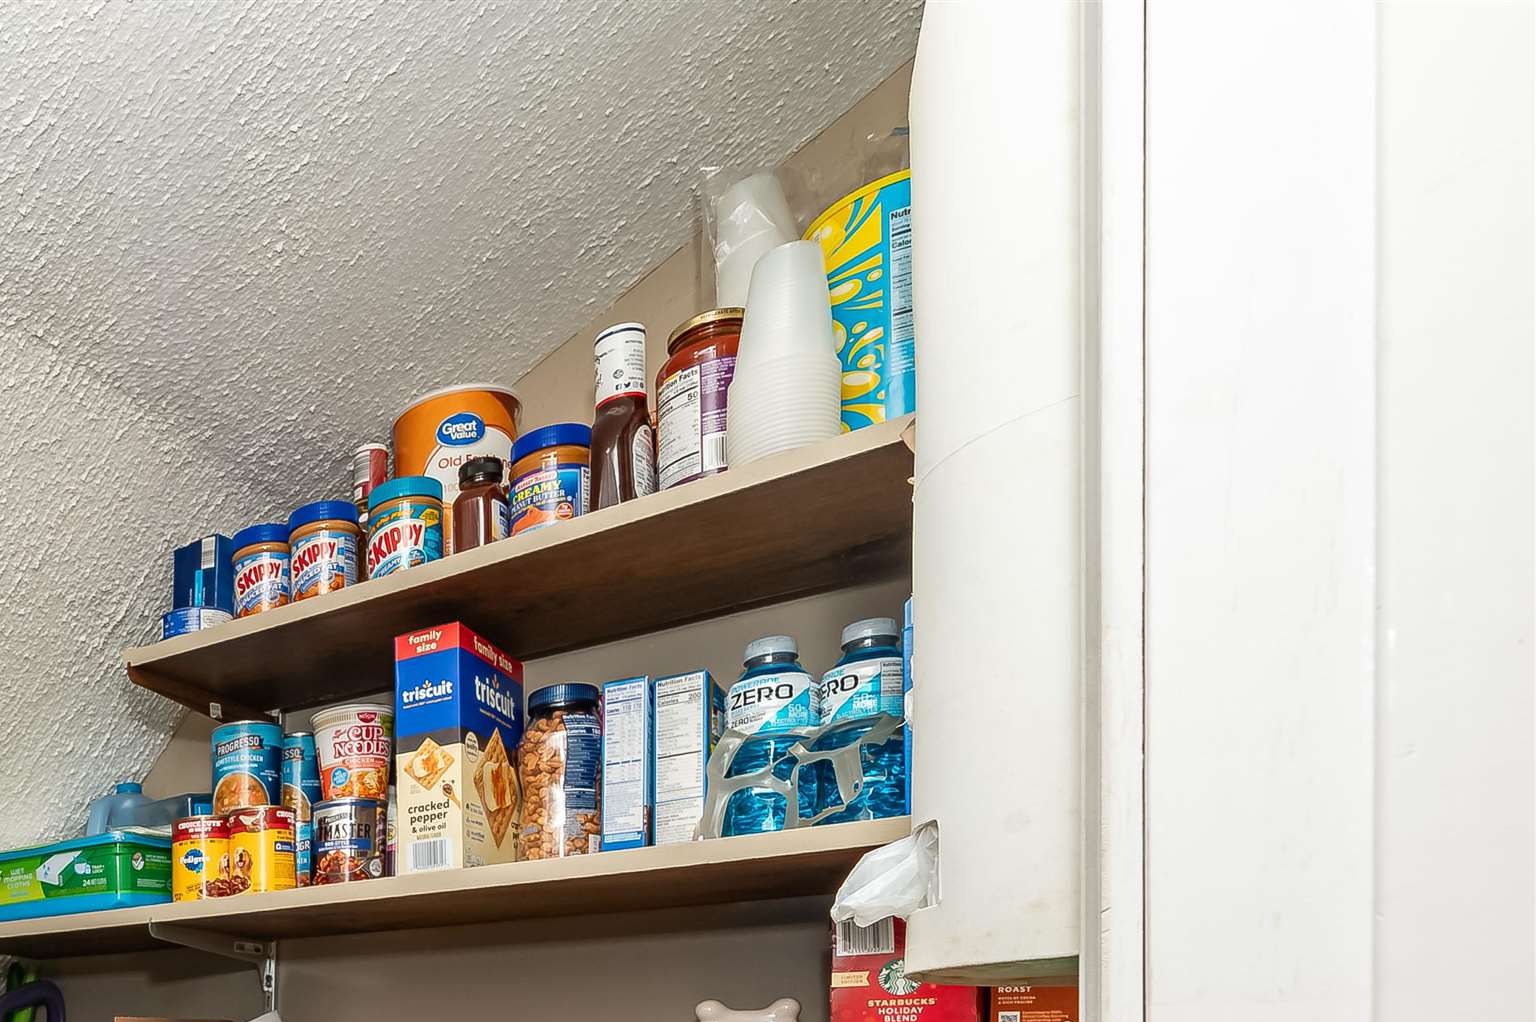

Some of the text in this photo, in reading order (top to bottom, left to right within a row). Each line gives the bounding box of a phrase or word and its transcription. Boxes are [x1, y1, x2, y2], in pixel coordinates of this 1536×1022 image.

[442, 420, 477, 434] Great
[439, 455, 461, 469] Old
[367, 524, 424, 573] SKIPPY
[409, 629, 442, 645] family
[416, 642, 437, 653] size
[474, 636, 512, 674] family size
[403, 680, 453, 703] triscuit
[475, 675, 515, 721] triscuit
[731, 684, 793, 711] ZERO
[347, 726, 384, 740] CUP
[217, 736, 260, 756] PROGRESSO
[333, 740, 391, 758] NOODLES
[408, 799, 450, 814] cracked
[410, 810, 448, 826] pepper
[320, 824, 371, 840] MASTER
[412, 823, 446, 834] & olive oil
[868, 998, 935, 1007] STARBUCKS
[878, 1006, 924, 1015] HOLIDAY
[884, 1014, 917, 1022] BLEND
